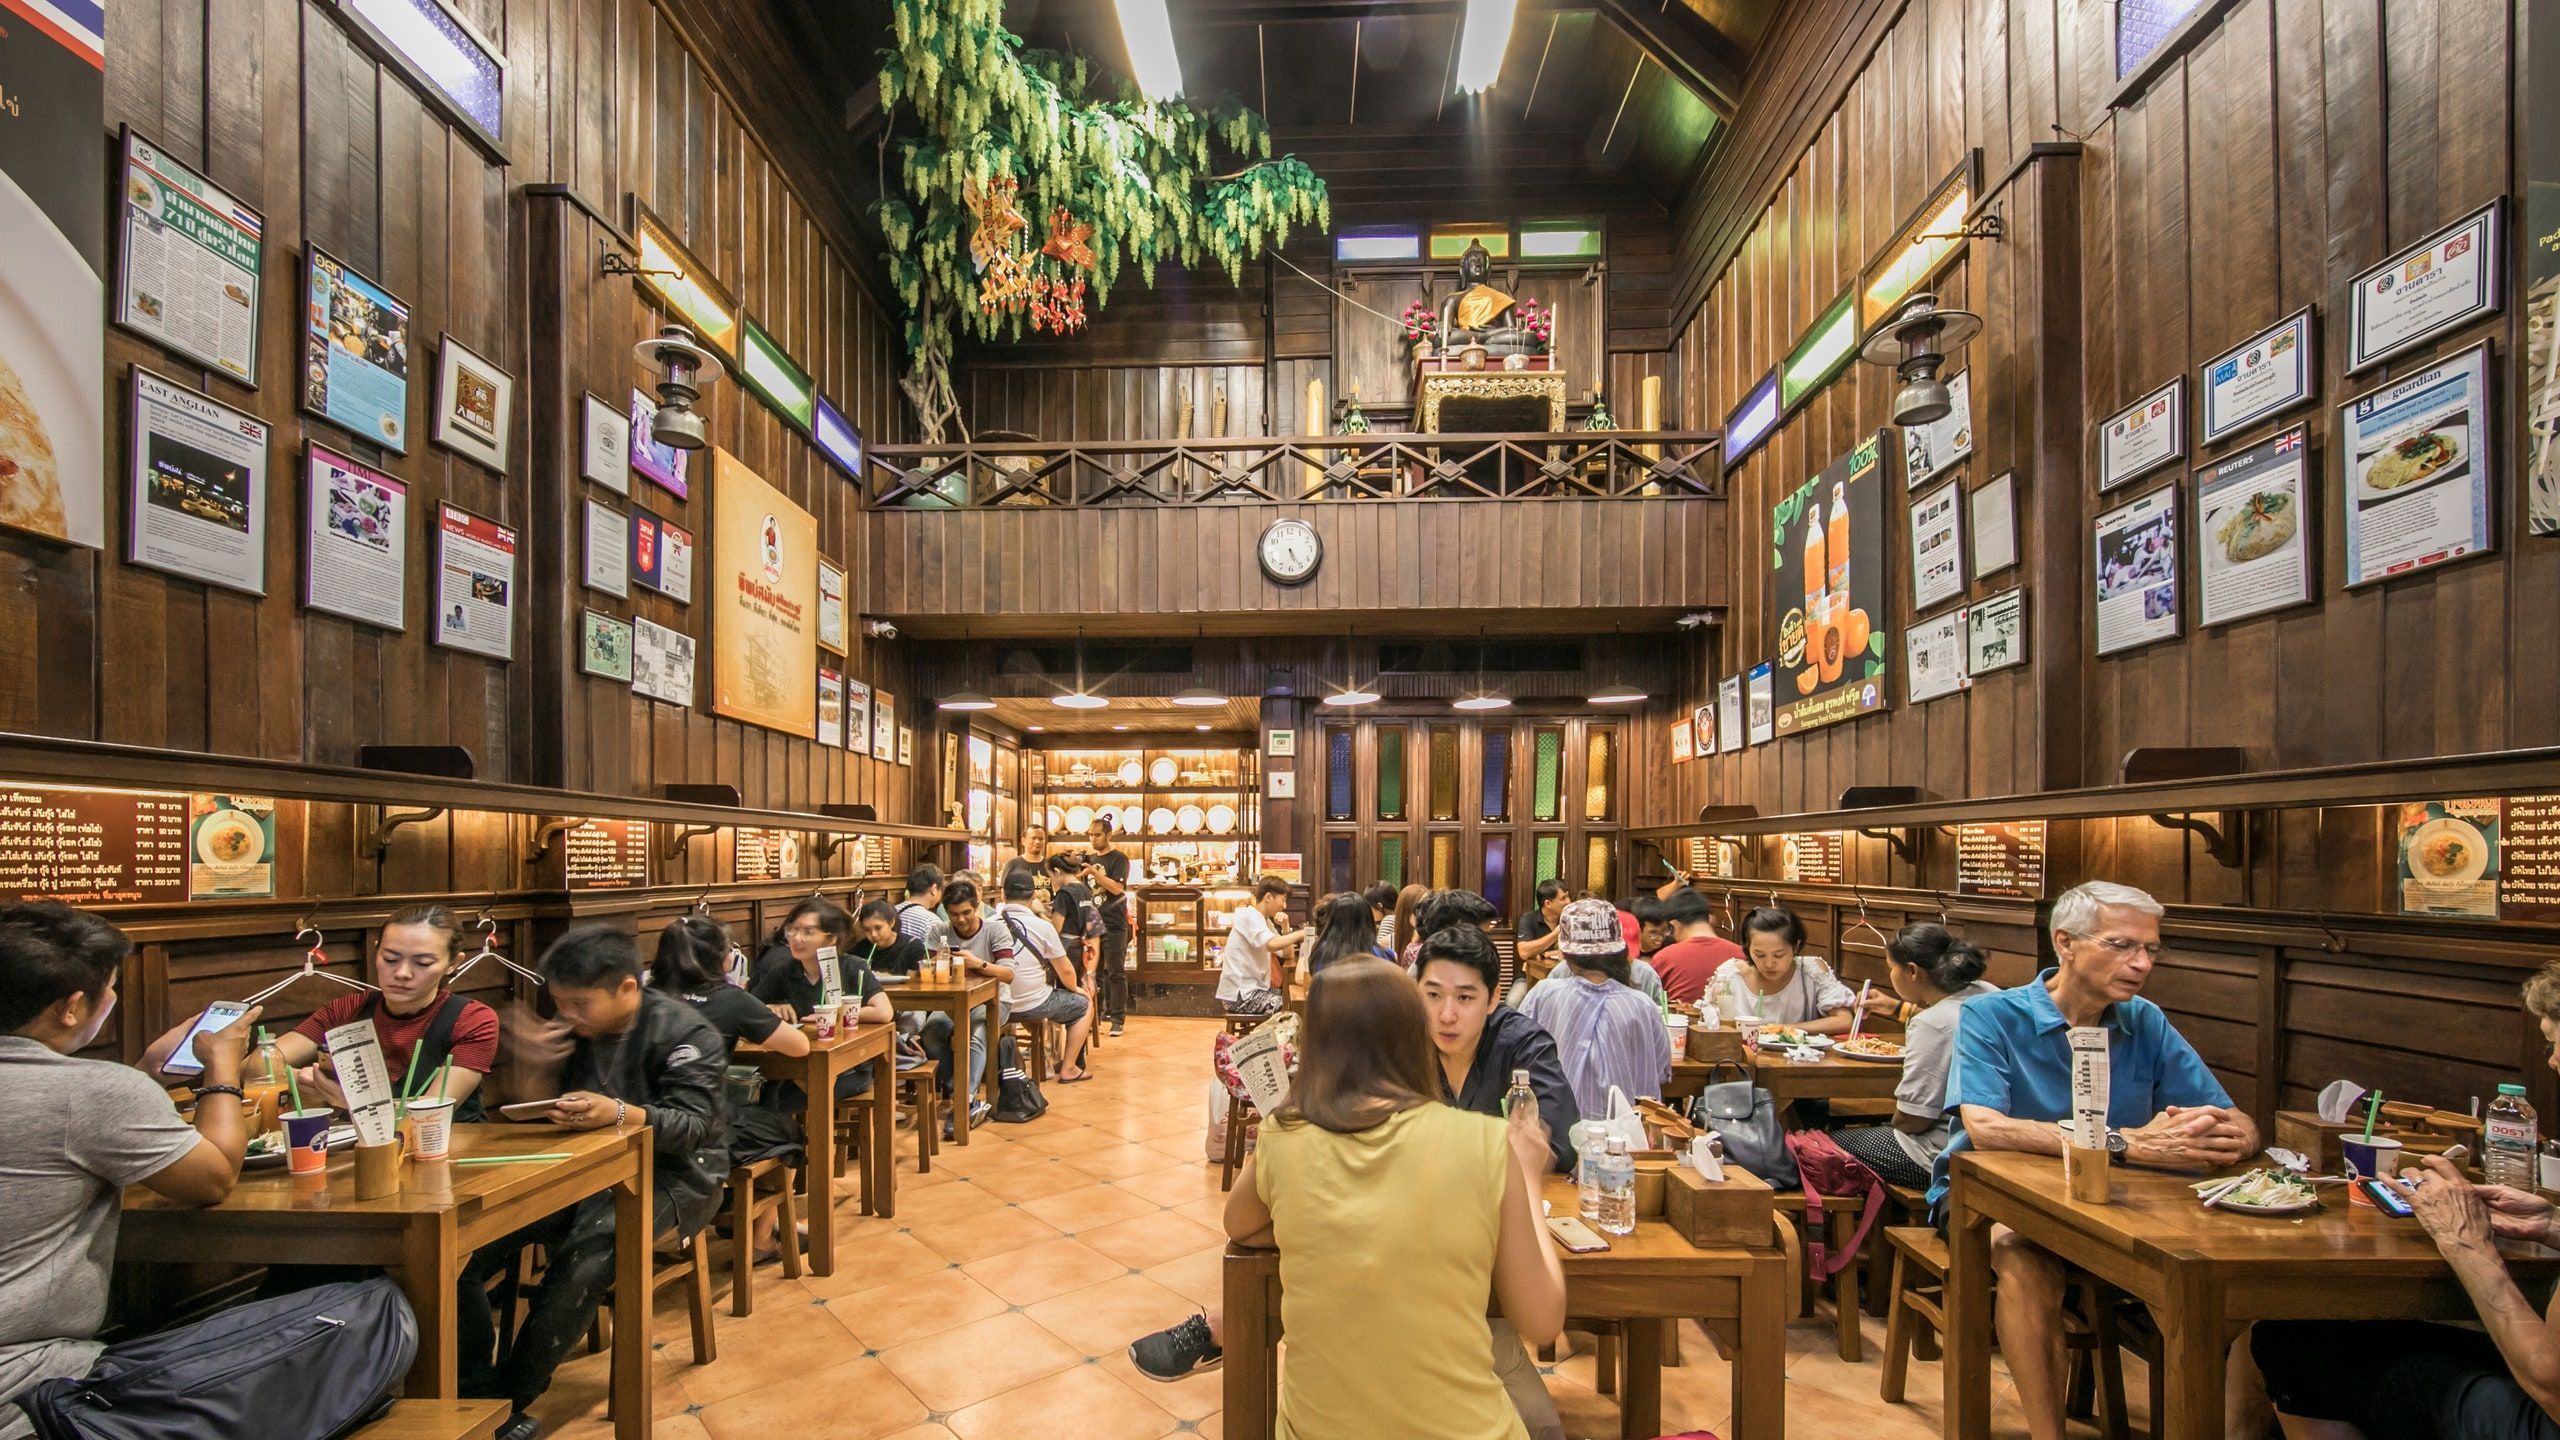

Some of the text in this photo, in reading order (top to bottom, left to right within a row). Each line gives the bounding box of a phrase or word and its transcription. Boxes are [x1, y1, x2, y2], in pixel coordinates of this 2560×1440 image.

[165, 206, 183, 226] 71
[2396, 268, 2443, 296] จานดารา
[2237, 361, 2271, 382] จานดารา
[140, 380, 219, 418] EAST ANGLIAN
[1849, 443, 1879, 475] 100%
[2218, 455, 2254, 475] REUTERS
[446, 508, 469, 525] BBC
[445, 523, 464, 536] NEWS
[2511, 807, 2535, 817] ผัดไทย
[136, 827, 154, 835] ราคา
[2511, 821, 2535, 831] ผัดไทย
[2511, 836, 2535, 846] ผัดไทย
[2511, 851, 2535, 860] ผัดไทย
[2511, 865, 2535, 875] ผัดไทย
[135, 879, 153, 887] ราคา
[2511, 880, 2536, 889] ผัดไทย
[2512, 893, 2536, 903] ผัดไทย
